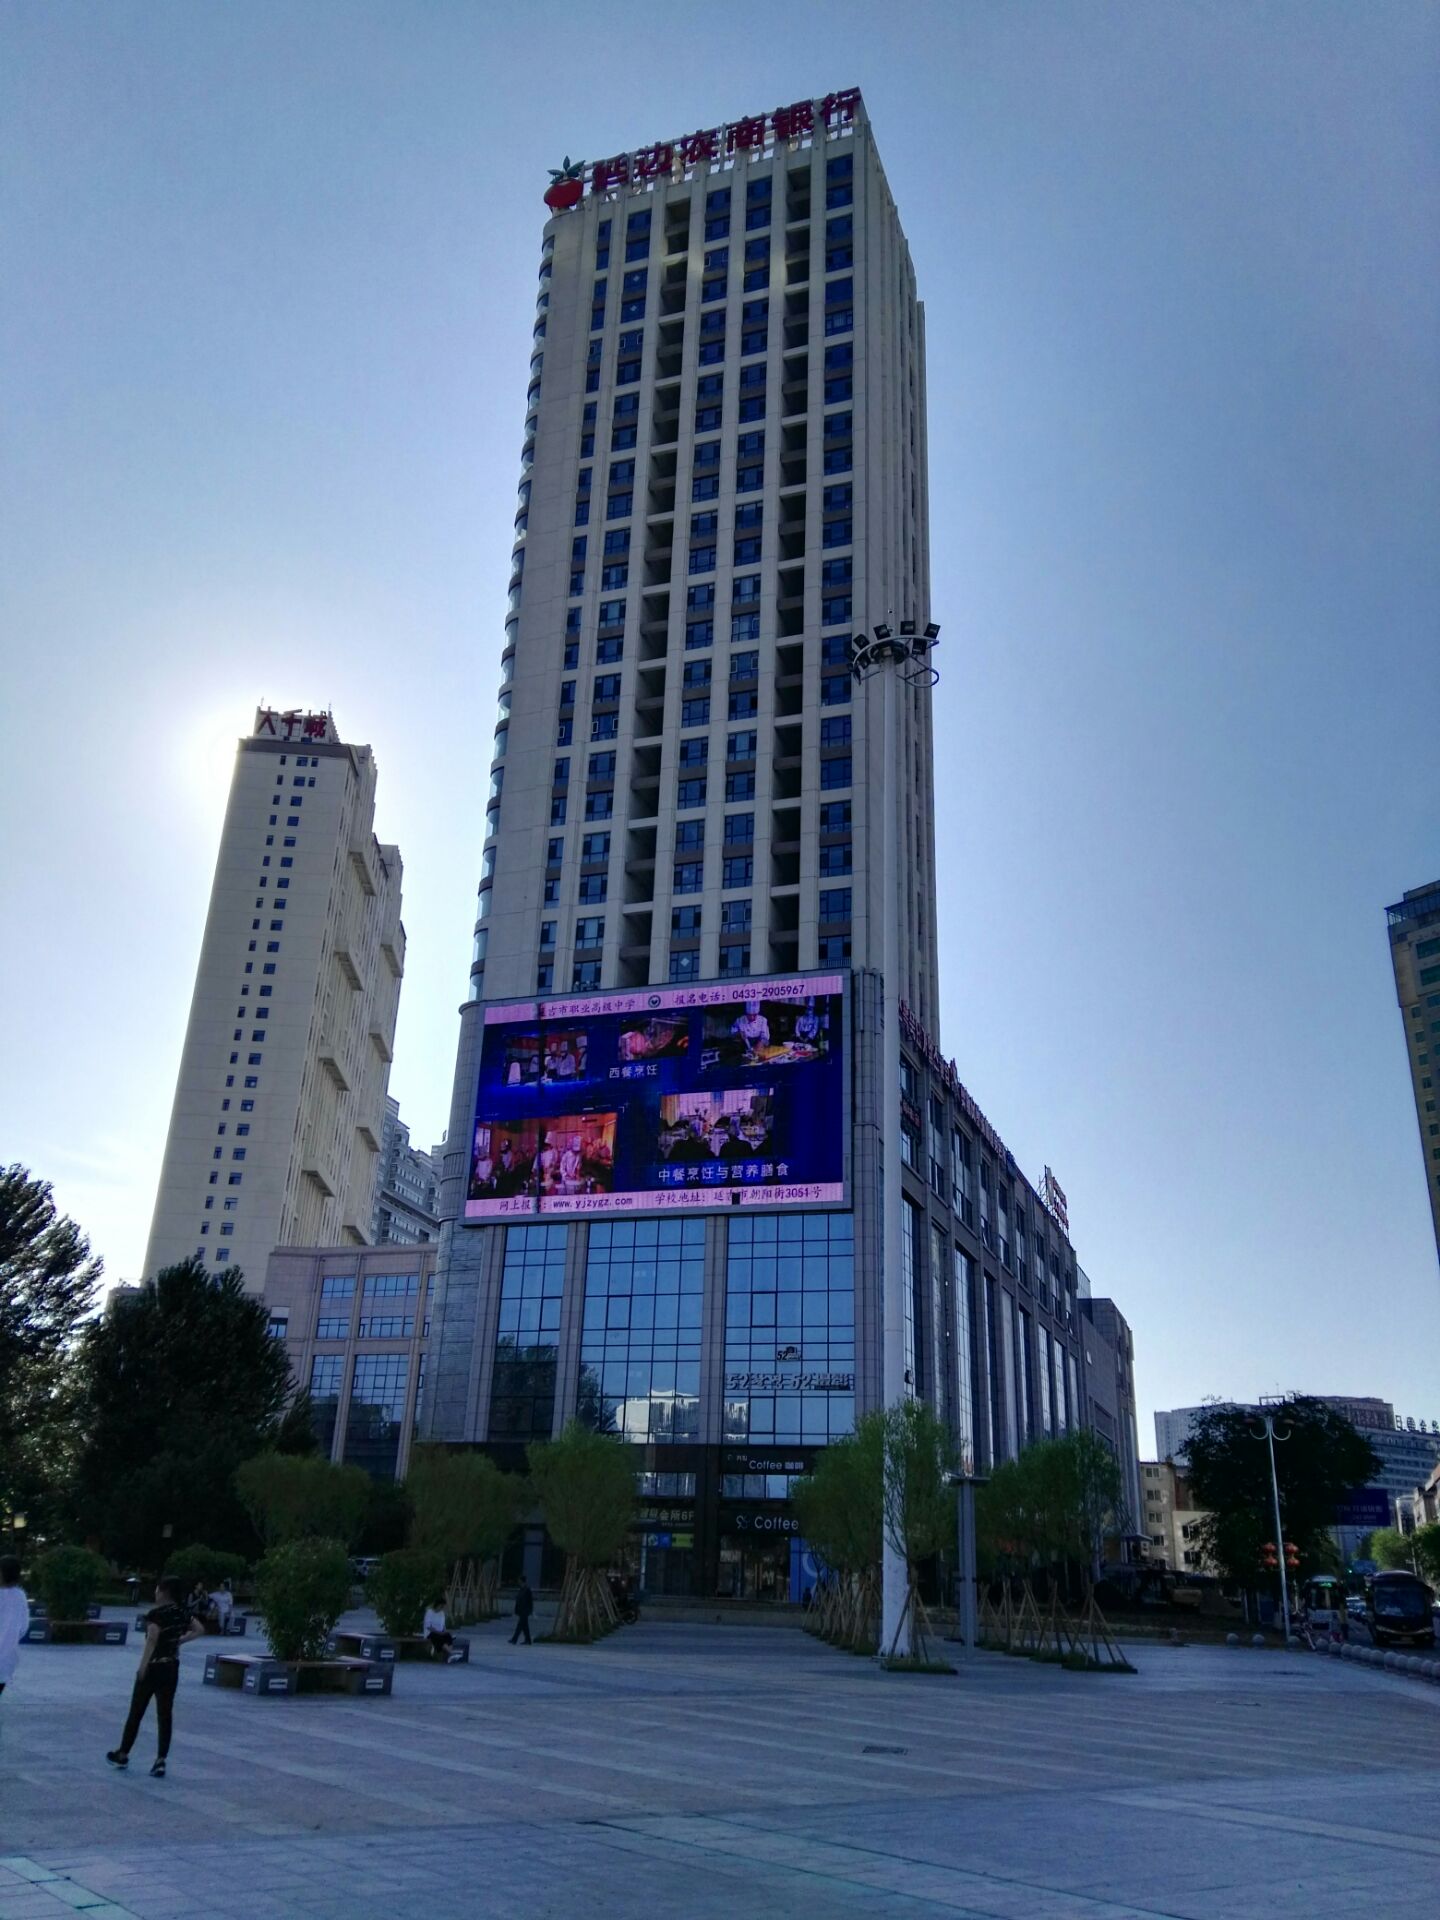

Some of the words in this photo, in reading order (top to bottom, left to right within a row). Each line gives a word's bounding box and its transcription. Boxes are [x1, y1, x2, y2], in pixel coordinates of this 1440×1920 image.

[608, 1063, 658, 1079] 西餐烹饪
[658, 1162, 790, 1183] 中餐烹饪与营养膳食
[749, 1460, 782, 1470] Coffee
[754, 1515, 799, 1531] Coffee
